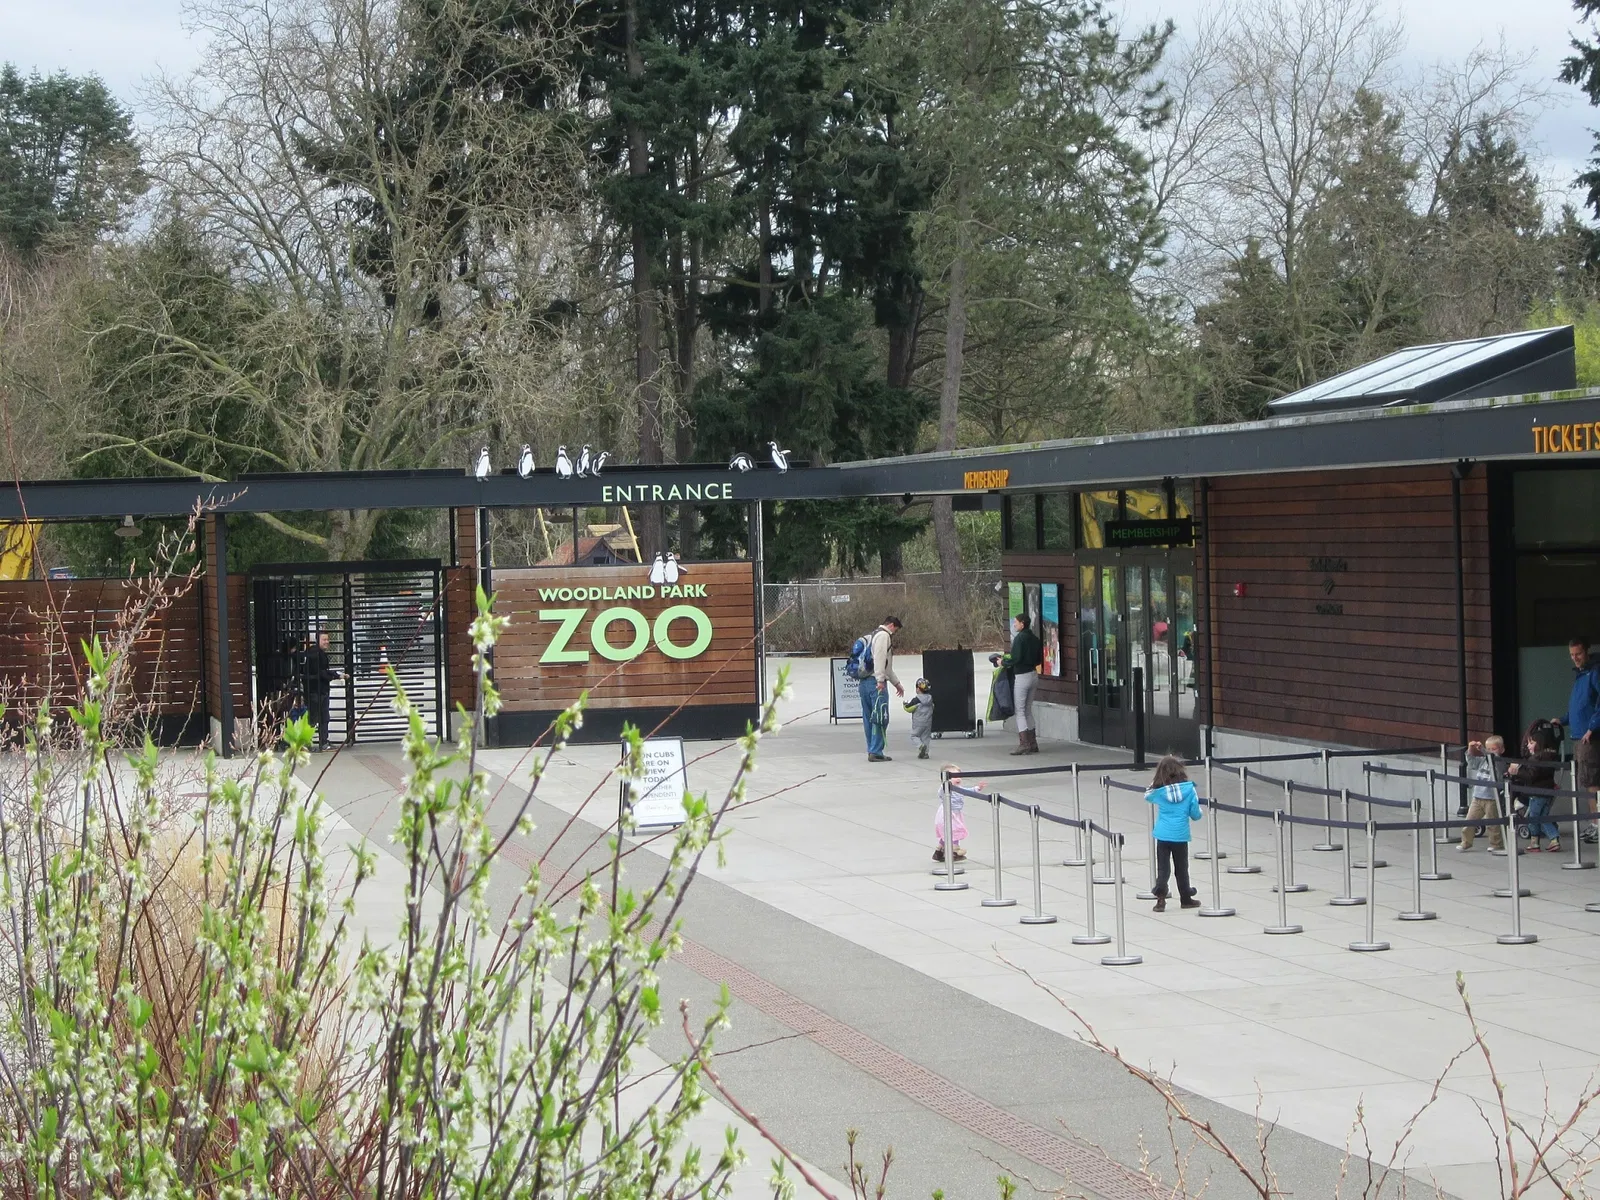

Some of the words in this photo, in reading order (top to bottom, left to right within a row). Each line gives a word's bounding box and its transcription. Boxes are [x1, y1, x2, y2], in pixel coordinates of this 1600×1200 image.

[1532, 421, 1600, 454] TICKETS
[964, 469, 1009, 489] MEMBERSHIP
[602, 483, 733, 502] ENTRANCE
[1112, 526, 1180, 539] MEMBERSHIP
[538, 585, 655, 602] WOODLAND
[660, 584, 708, 599] PARK
[538, 604, 713, 663] ZOO
